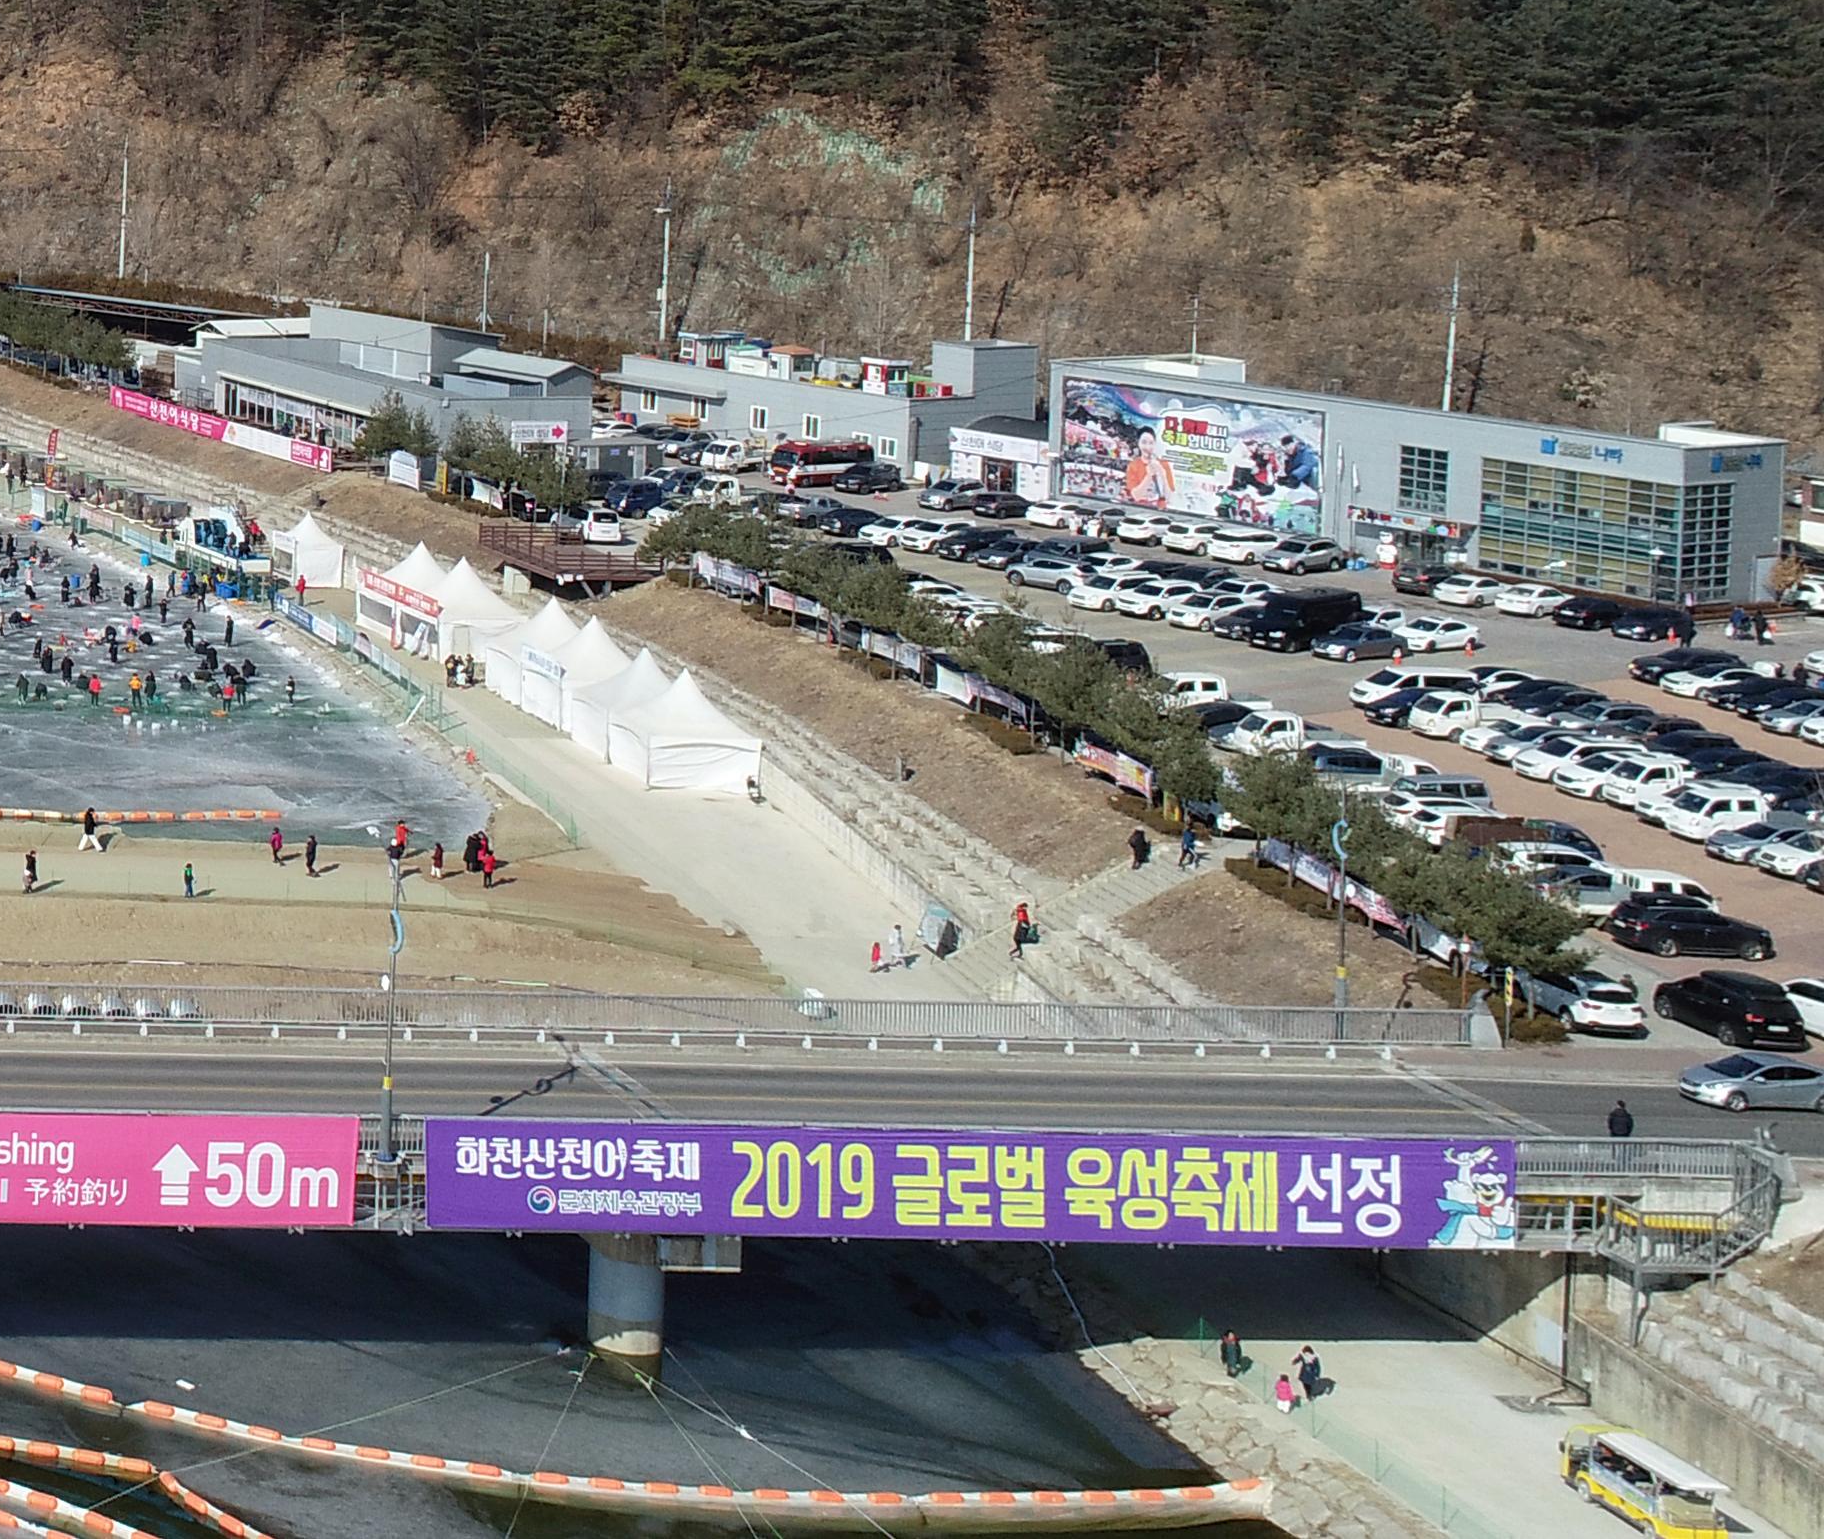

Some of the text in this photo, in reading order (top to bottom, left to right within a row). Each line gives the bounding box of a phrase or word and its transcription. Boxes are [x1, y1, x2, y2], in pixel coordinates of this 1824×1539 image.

[203, 1141, 339, 1209] 50m
[456, 1136, 700, 1182] 화천산천어축제
[24, 1177, 129, 1207] 予約釣り
[558, 1189, 702, 1216] 문화체육관광부
[730, 1141, 1403, 1238] 2019 글로벌 육성축제 선정
